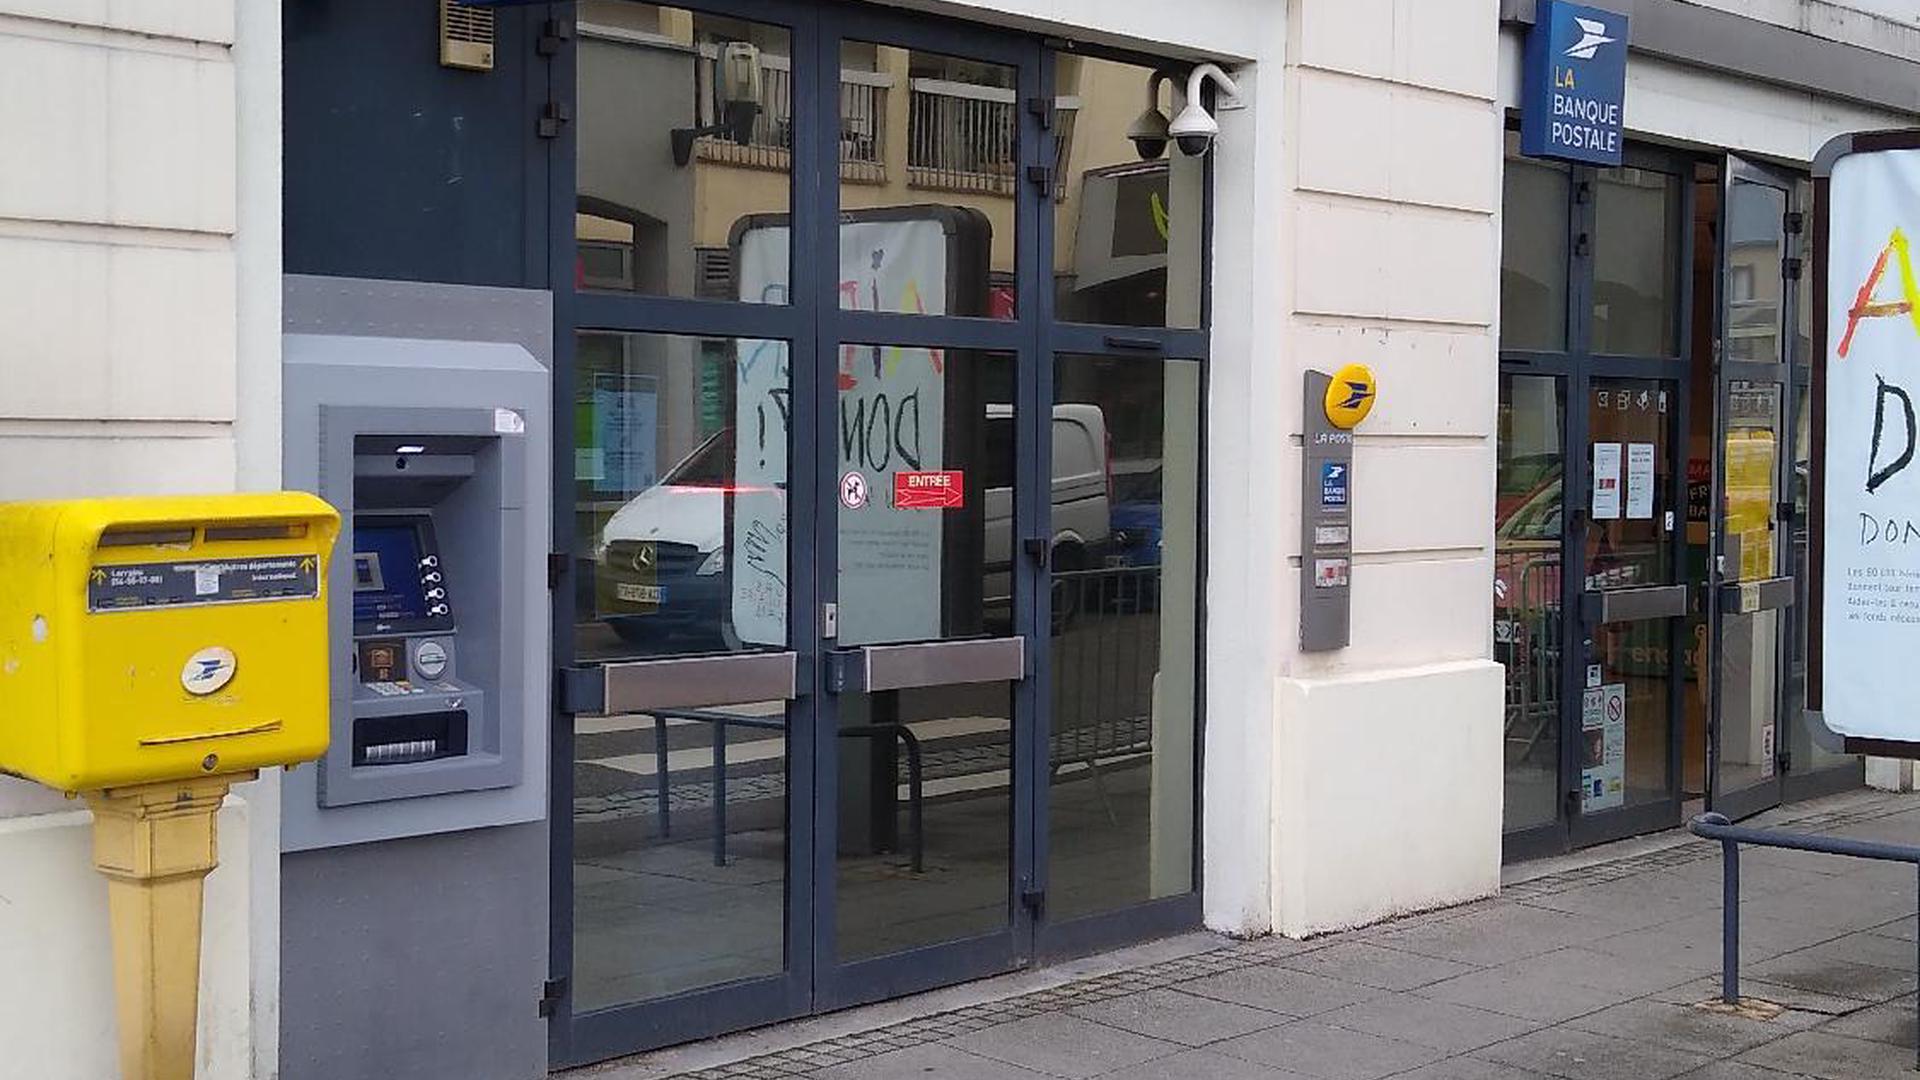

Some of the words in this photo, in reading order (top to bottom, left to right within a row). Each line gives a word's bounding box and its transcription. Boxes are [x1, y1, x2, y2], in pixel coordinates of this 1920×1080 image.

[1556, 65, 1574, 89] LA
[1554, 94, 1618, 124] BANQUE
[1552, 122, 1617, 152] POSTALE
